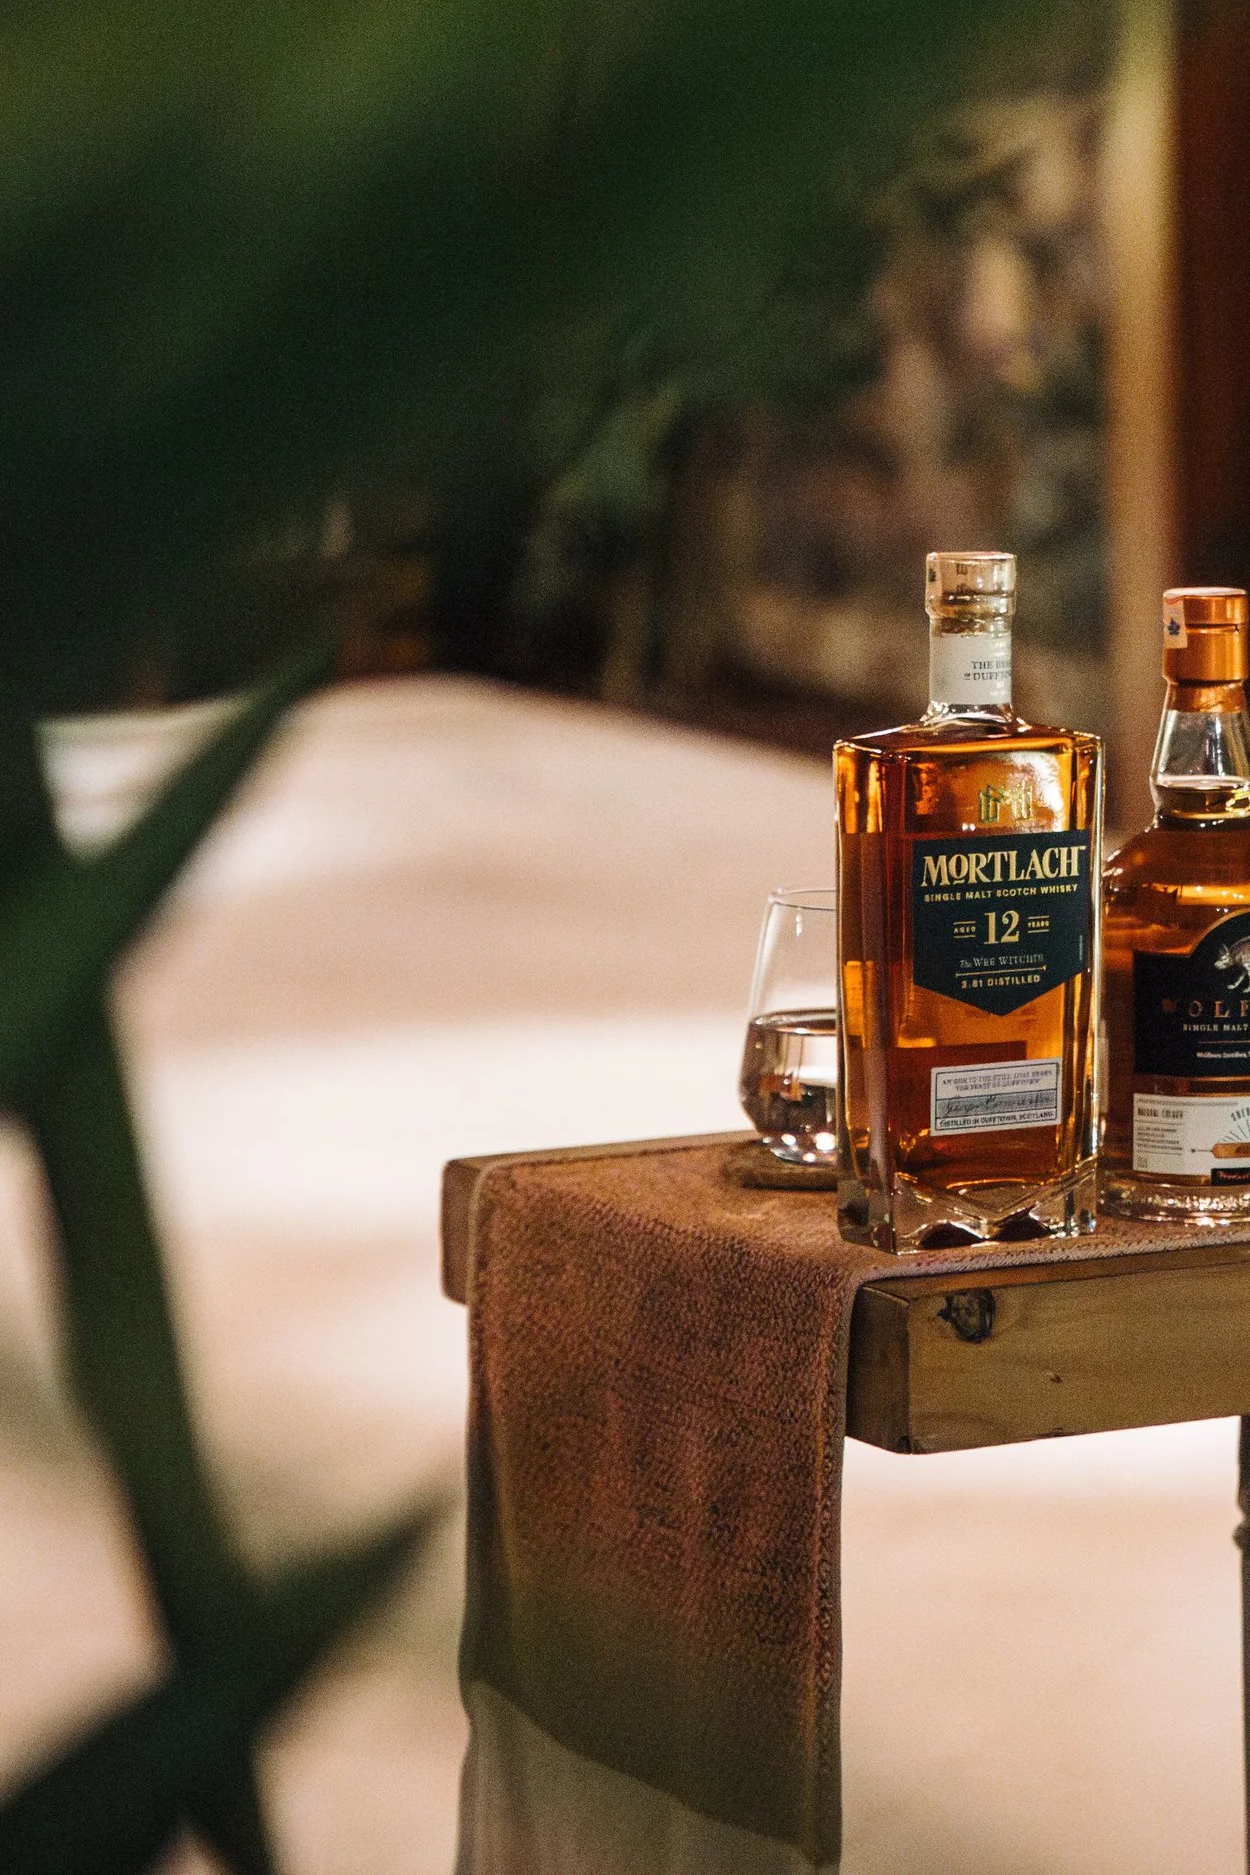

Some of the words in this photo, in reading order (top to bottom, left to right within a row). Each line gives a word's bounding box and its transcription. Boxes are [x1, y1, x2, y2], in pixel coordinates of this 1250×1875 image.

[971, 660, 992, 670] THE
[921, 846, 1080, 888] MORTLACH
[924, 891, 961, 903] SINGLE
[965, 888, 992, 899] MALT
[996, 887, 1037, 898] SCOTCH
[1040, 883, 1078, 895] WHISKY
[983, 909, 1020, 945] 12
[973, 956, 996, 967] WEE
[961, 978, 983, 990] 2.81
[987, 974, 1041, 987] DISTILLED
[1183, 1023, 1218, 1032] SINGLE
[1223, 1023, 1248, 1031] MALT
